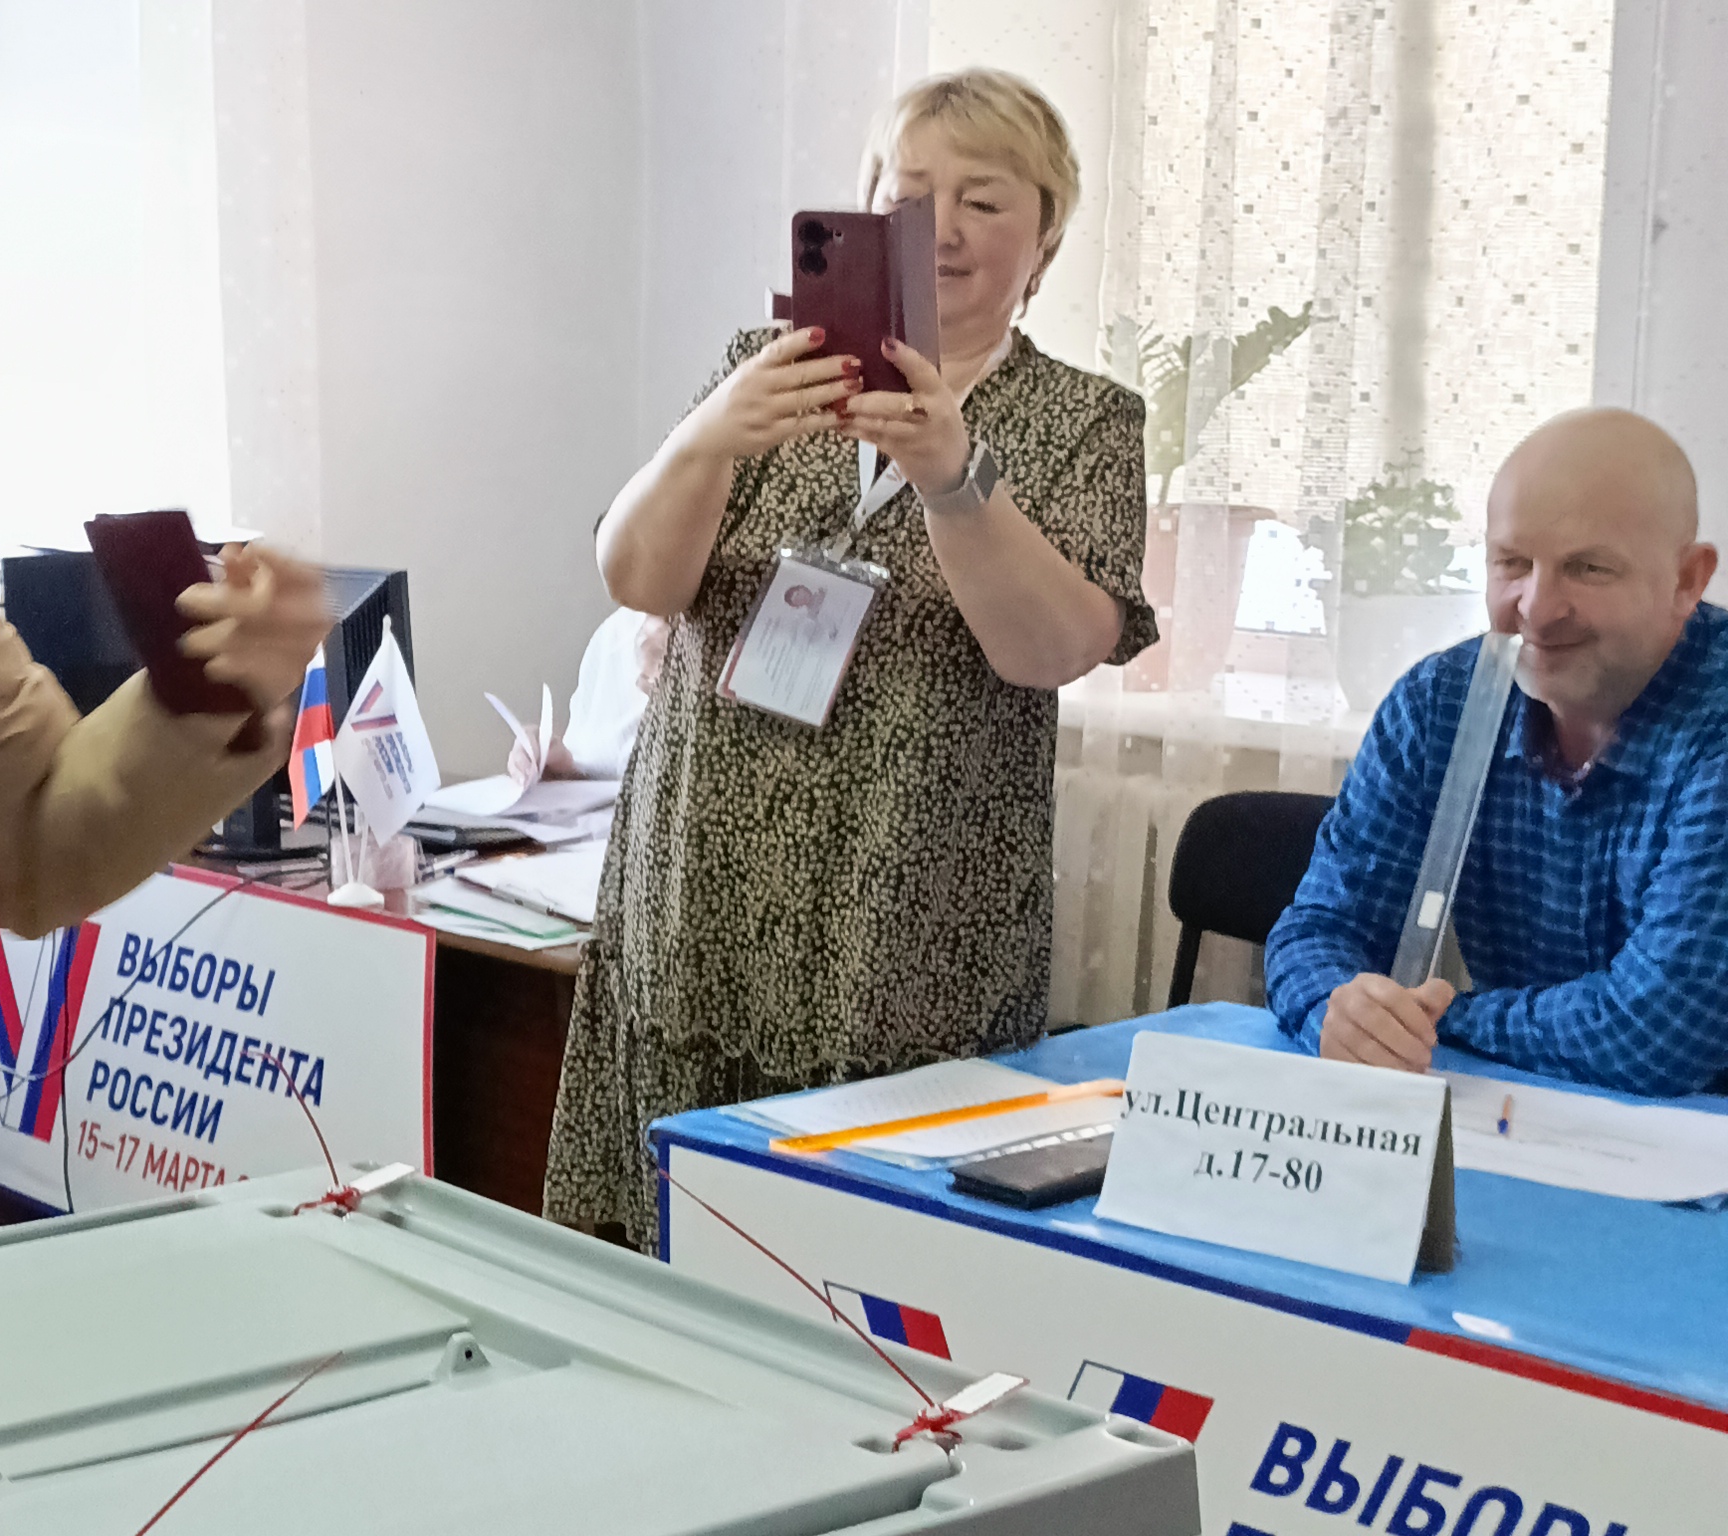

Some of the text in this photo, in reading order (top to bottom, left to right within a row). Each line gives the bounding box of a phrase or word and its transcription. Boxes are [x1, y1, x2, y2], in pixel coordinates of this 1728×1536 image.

[116, 932, 276, 1016] ВЫБОРЫ
[100, 996, 326, 1107] ПРЕЗИДЕНТА
[86, 1060, 225, 1144] РОССИИ
[1121, 1087, 1422, 1156] ул.Центральная
[1194, 1149, 1323, 1194] д.17-80
